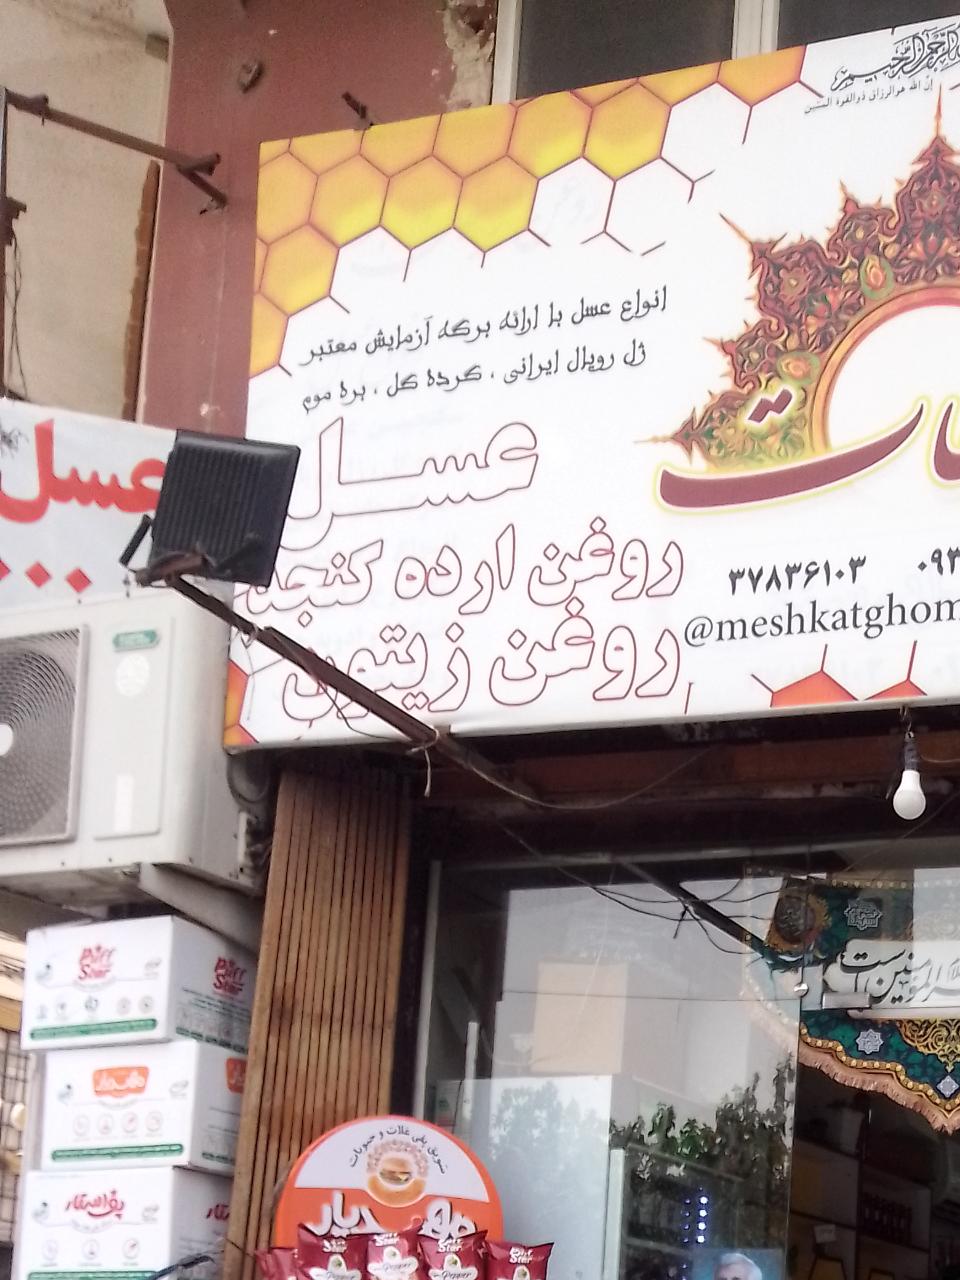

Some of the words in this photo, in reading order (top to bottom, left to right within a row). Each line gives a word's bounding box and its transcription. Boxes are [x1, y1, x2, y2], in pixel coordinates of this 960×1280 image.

[548, 301, 563, 328] با
[571, 297, 611, 325] عسل
[619, 284, 667, 322] انواع
[298, 339, 357, 366] معتبر
[365, 316, 433, 354] آزمایش
[623, 338, 646, 366] ژل
[503, 349, 559, 384] ایرانی
[567, 345, 614, 373] رویال
[302, 391, 332, 414] موم
[0, 418, 167, 524] عسل
[284, 416, 539, 551] عسل
[394, 523, 517, 616] ارده
[527, 516, 685, 609] روغن
[728, 555, 868, 596] ۳۷۸۳۶۱۰۳
[244, 538, 384, 628] کنجد
[489, 597, 681, 706] روغن
[281, 622, 471, 721] زیتون
